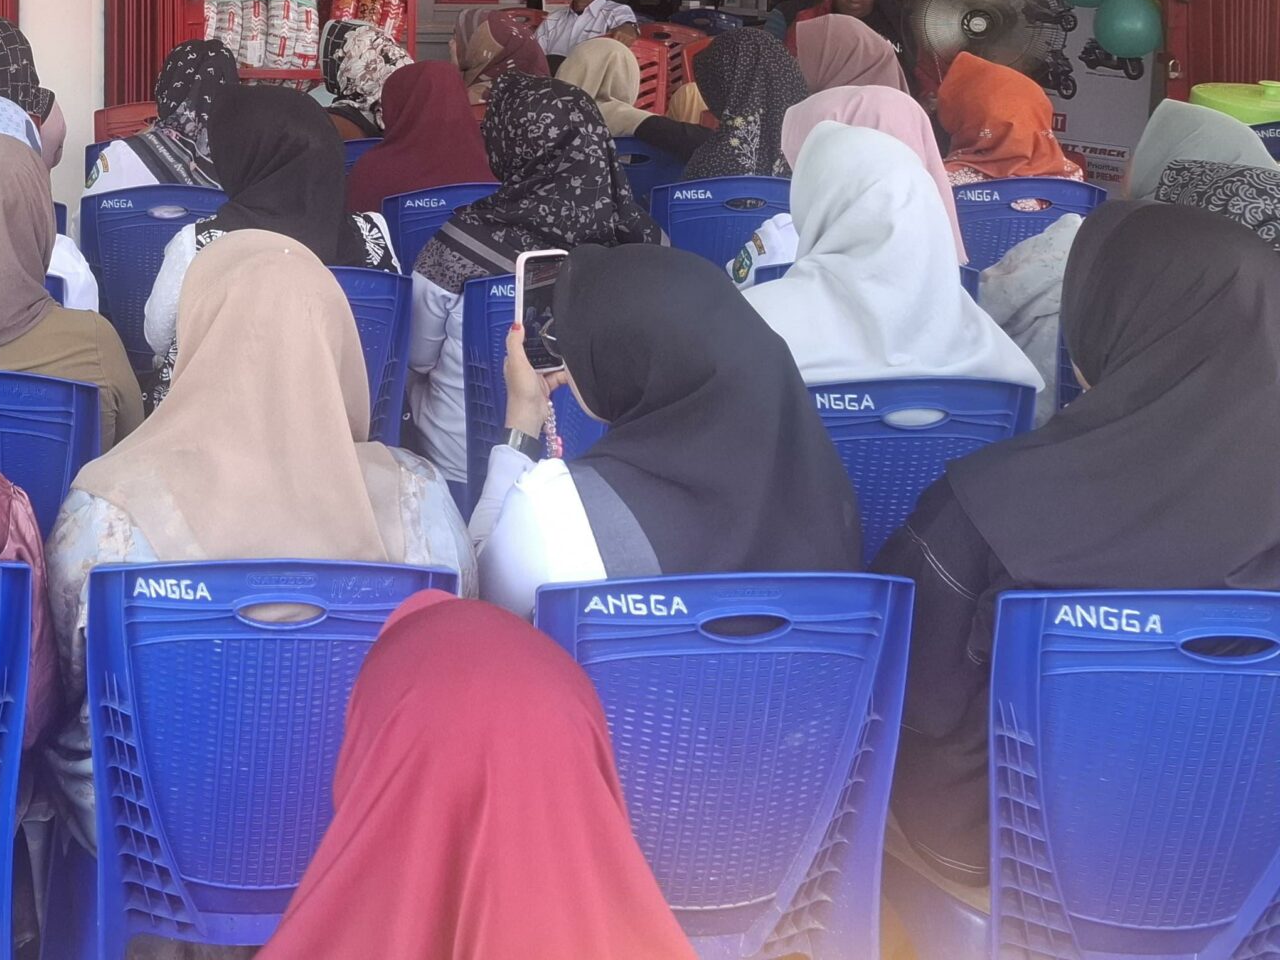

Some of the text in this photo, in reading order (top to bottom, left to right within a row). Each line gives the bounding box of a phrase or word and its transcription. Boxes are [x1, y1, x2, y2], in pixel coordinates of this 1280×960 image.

[1082, 145, 1127, 158] TRACK
[1087, 161, 1119, 172] Prioritas
[673, 189, 713, 200] ANGGA
[956, 190, 1000, 202] ANGGA
[100, 199, 134, 209] ANGGA
[404, 198, 447, 208] ANGGA
[489, 284, 516, 297] ANG
[815, 392, 875, 410] NGGA
[132, 576, 212, 601] ANGGA
[584, 592, 688, 616] ANGGA
[1054, 603, 1164, 634] ANGGA
